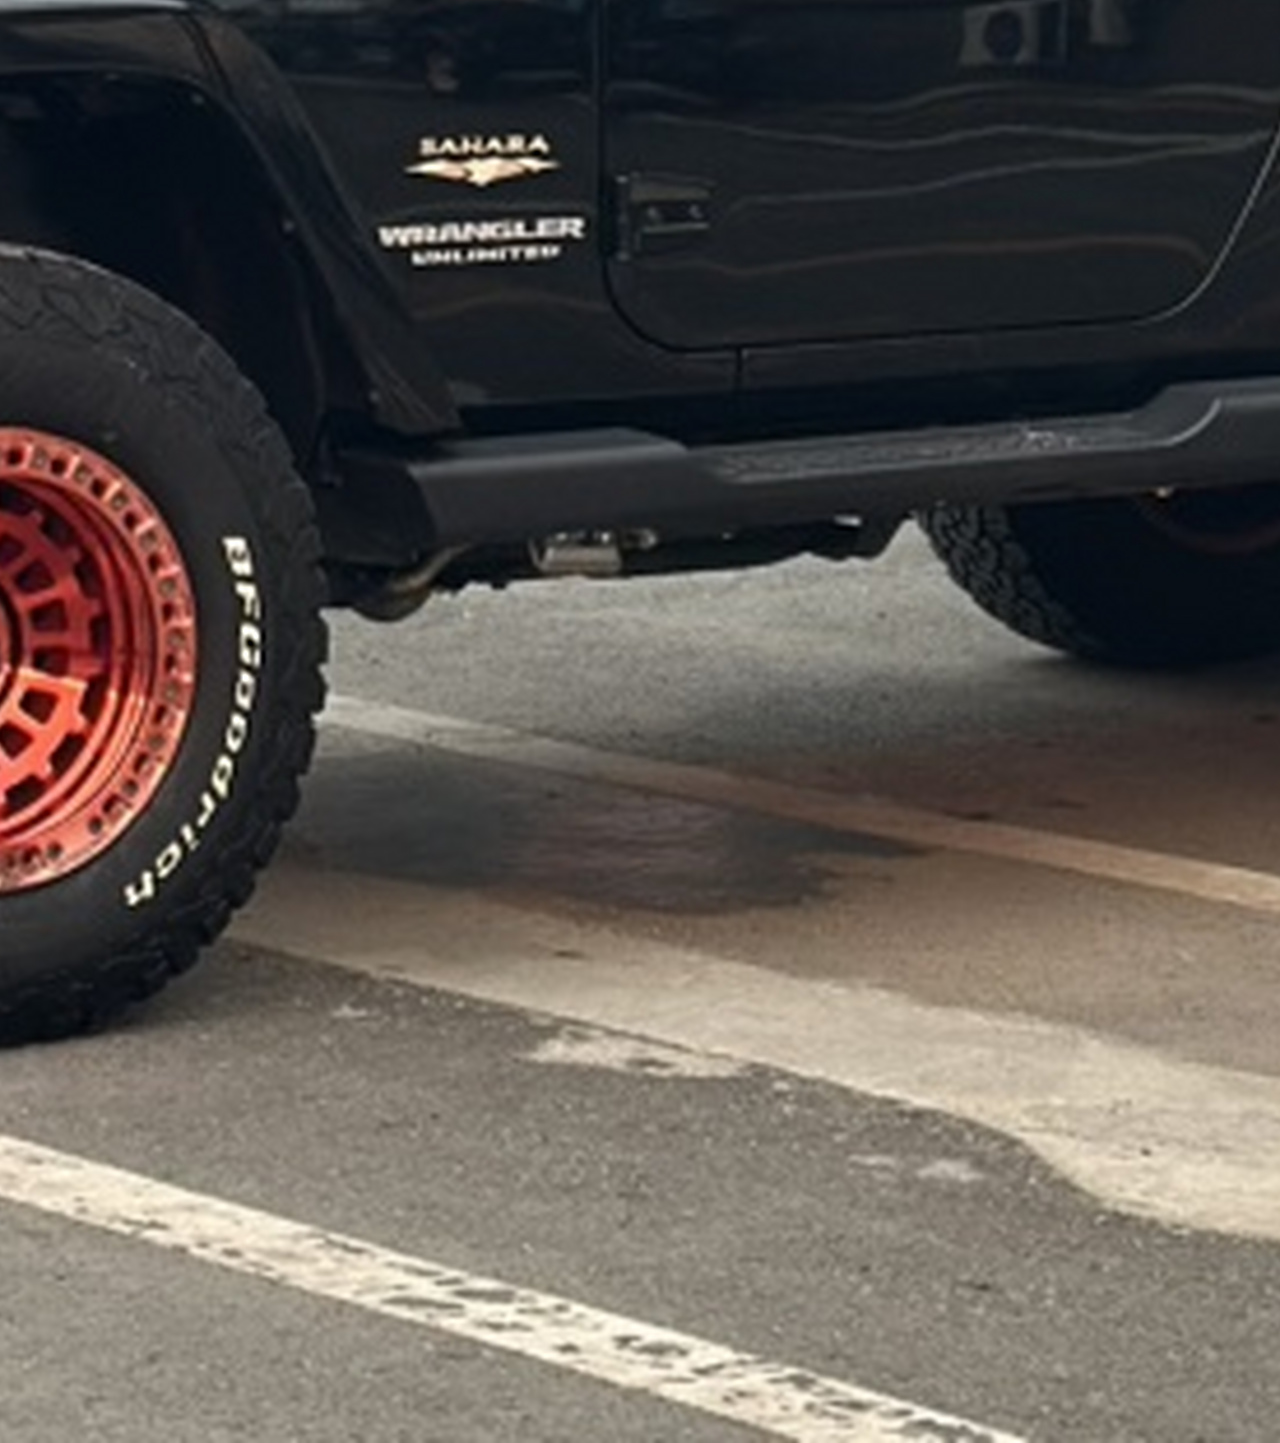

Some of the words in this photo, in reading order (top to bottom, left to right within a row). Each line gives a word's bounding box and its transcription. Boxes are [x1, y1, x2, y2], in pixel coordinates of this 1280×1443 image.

[419, 134, 550, 156] SAHARA
[377, 216, 586, 248] WRANGLER
[410, 244, 562, 266] UNLIMITED
[124, 535, 263, 908] BFGoodrich
